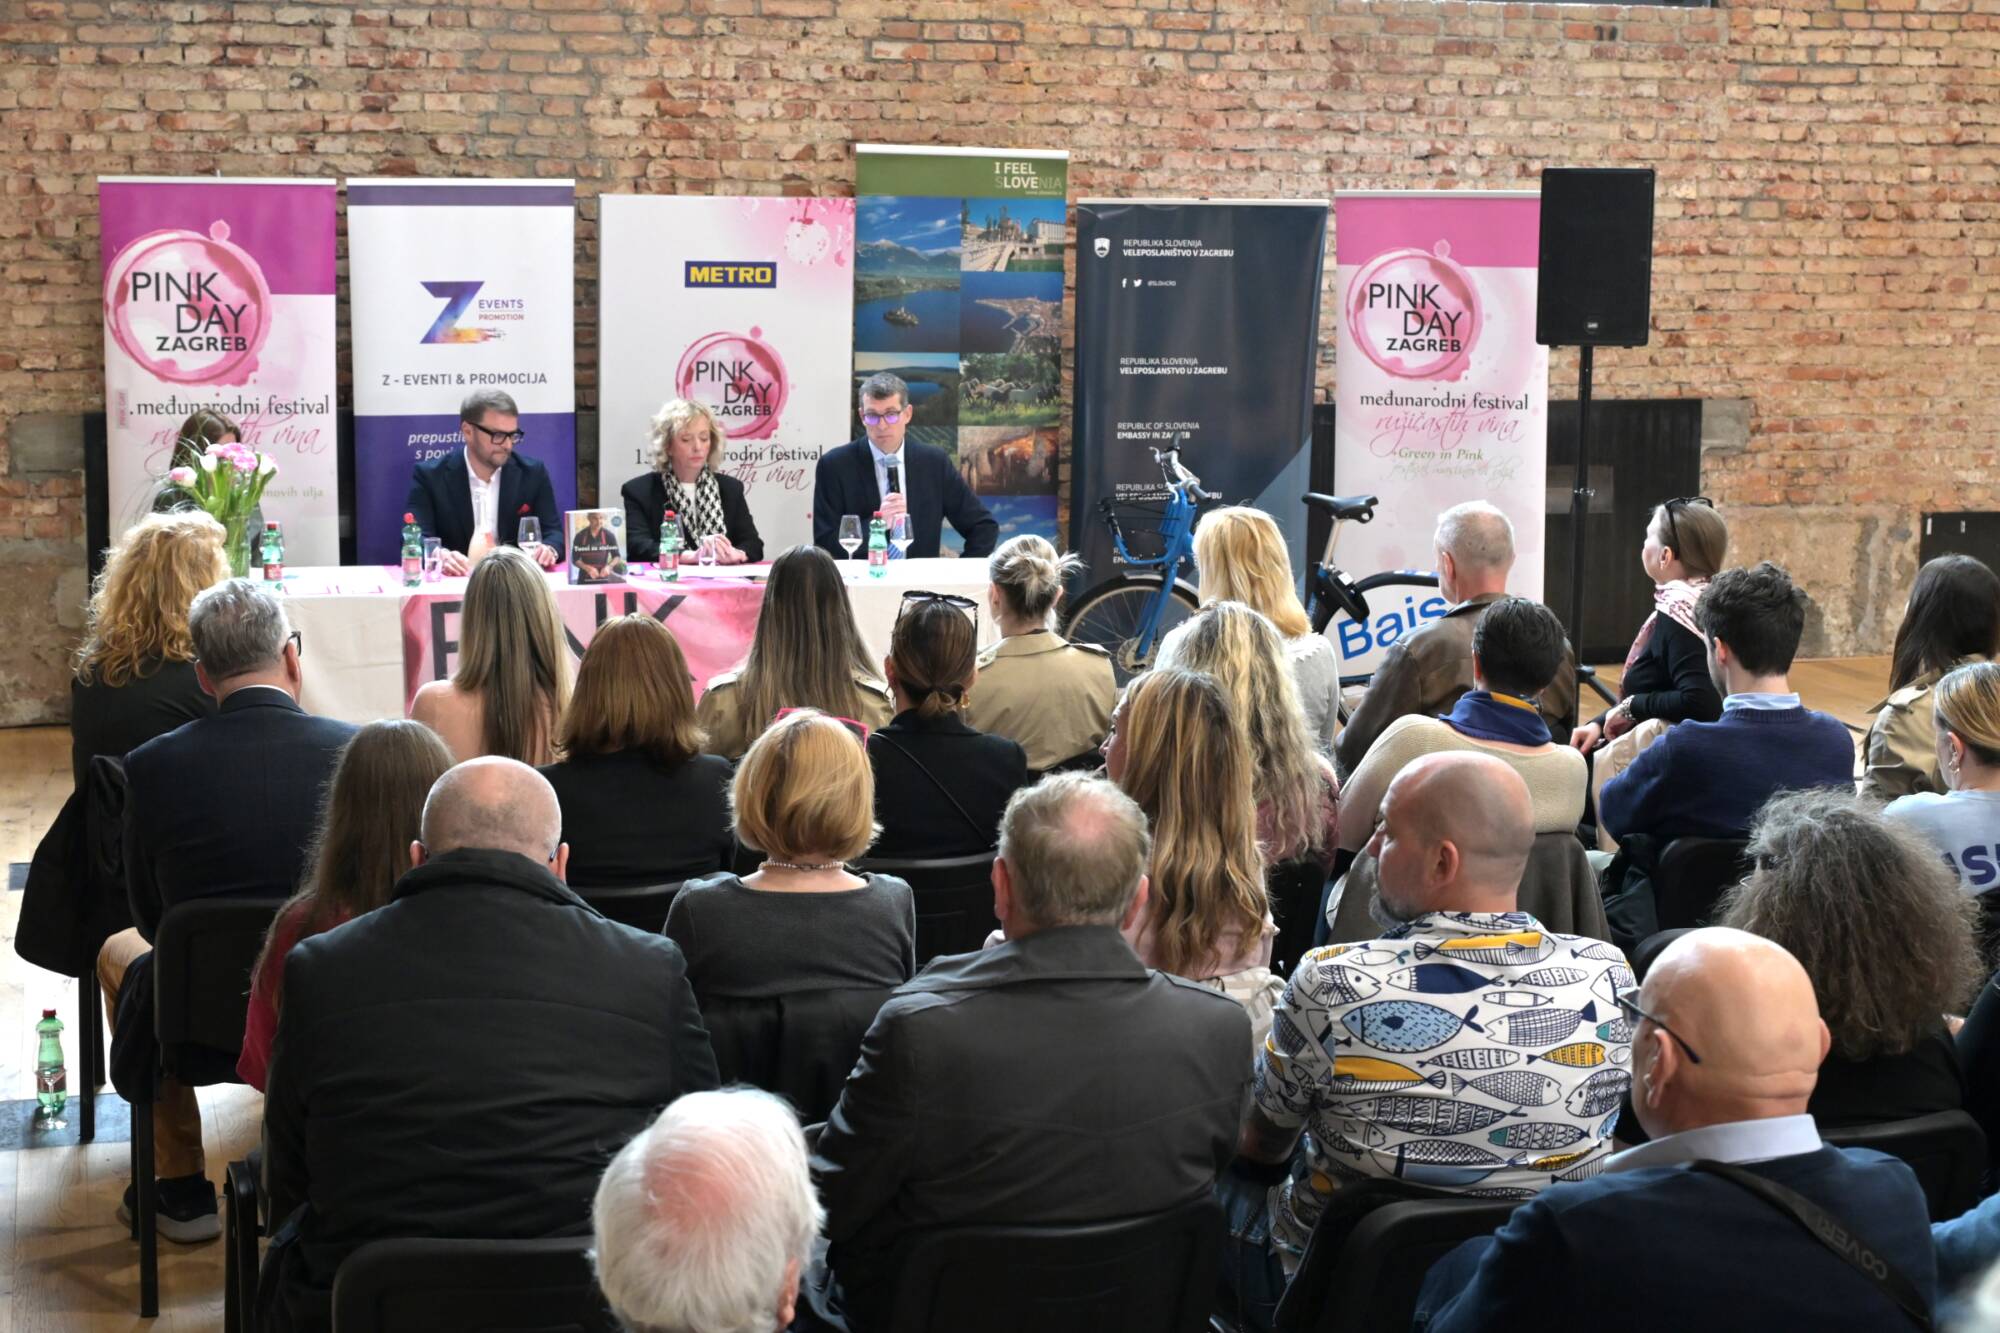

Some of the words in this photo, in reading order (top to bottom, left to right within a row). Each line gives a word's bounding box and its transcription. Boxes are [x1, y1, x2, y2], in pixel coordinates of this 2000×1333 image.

[994, 162, 1001, 174] I
[1003, 162, 1036, 175] FEEL
[1123, 239, 1164, 247] REPUBLIKA
[1165, 239, 1203, 248] SLOVENIJA
[1122, 248, 1192, 257] VELEPOSLANIŠTVO
[1193, 249, 1199, 257] V
[1200, 249, 1235, 257] ZAGREBU
[689, 266, 772, 283] METRO
[132, 272, 222, 302] PINK
[478, 298, 524, 309] EVENTS
[1369, 283, 1441, 309] PINK
[176, 304, 247, 334] DAY
[1403, 311, 1462, 336] DAY
[156, 336, 248, 351] ZAGREB
[1386, 338, 1462, 352] ZAGREB
[1120, 357, 1160, 365] REPUBLIKA
[1161, 357, 1198, 366] SLOVENIJA
[695, 361, 756, 382] PINK
[1186, 367, 1192, 375] U
[1193, 367, 1228, 375] ZAGREBU
[382, 374, 390, 386] Z
[403, 374, 452, 386] EVENTI
[456, 373, 465, 385] &
[469, 372, 548, 385] PROMOCIJA
[724, 382, 773, 403] DAY
[1360, 389, 1466, 409] međunarodni
[1472, 392, 1529, 410] festival
[268, 393, 329, 415] festival
[1117, 422, 1153, 430] REPUBLIC
[1153, 422, 1164, 430] OF
[1164, 422, 1200, 430] SLOVENIA
[1478, 415, 1525, 443] vina
[1116, 431, 1151, 440] EMBASSY
[1152, 431, 1160, 439] IN
[771, 444, 822, 460] festival
[1440, 448, 1452, 460] in
[1456, 448, 1484, 461] Pink
[766, 465, 810, 491] vina
